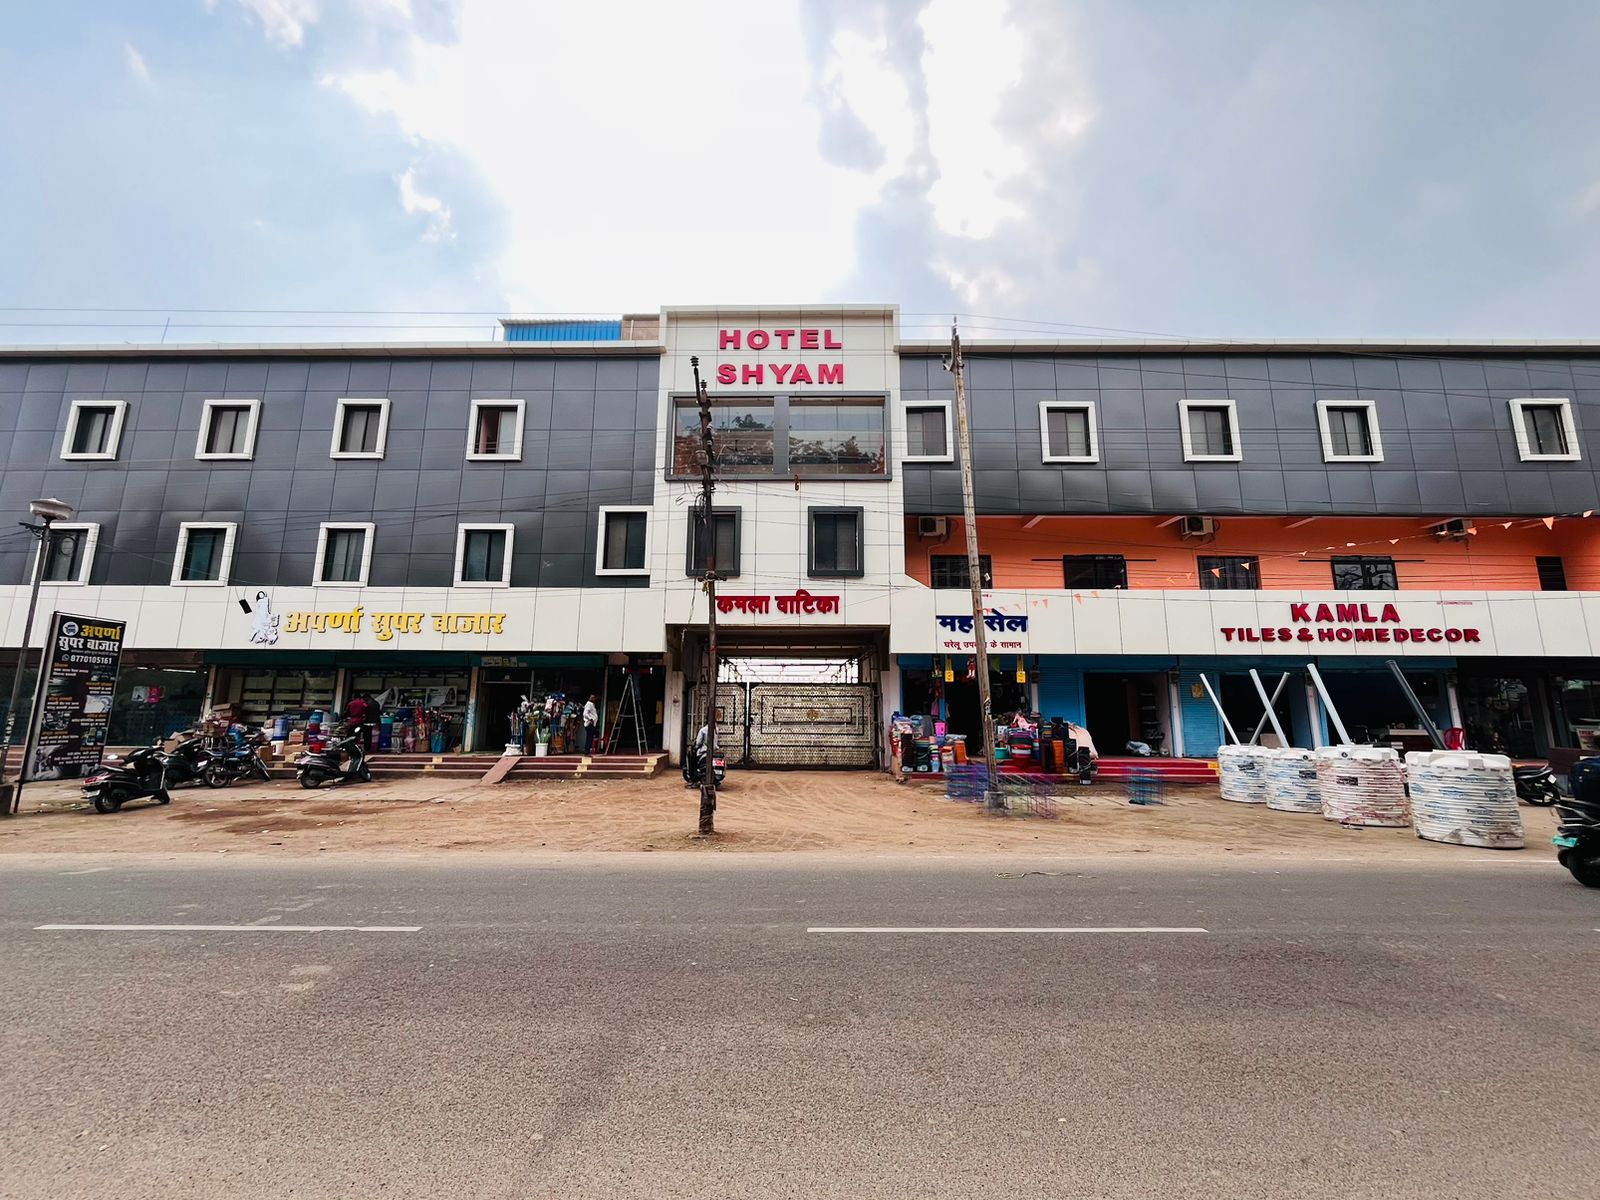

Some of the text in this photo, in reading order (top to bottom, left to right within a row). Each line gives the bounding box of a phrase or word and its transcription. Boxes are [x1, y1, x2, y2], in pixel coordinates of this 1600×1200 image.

[719, 329, 842, 350] HOTEL
[717, 364, 844, 384] SHYAM
[715, 588, 840, 614] कमला वाटिका
[1290, 603, 1401, 623] KAMLA
[81, 625, 121, 639] अपर्णा
[284, 606, 364, 633] अपर्णा
[371, 612, 425, 641] सुपर
[59, 636, 119, 652] सुपर बाजार
[944, 640, 961, 650] घरेलू
[1220, 627, 1481, 643] TILES & HOME DECOR
